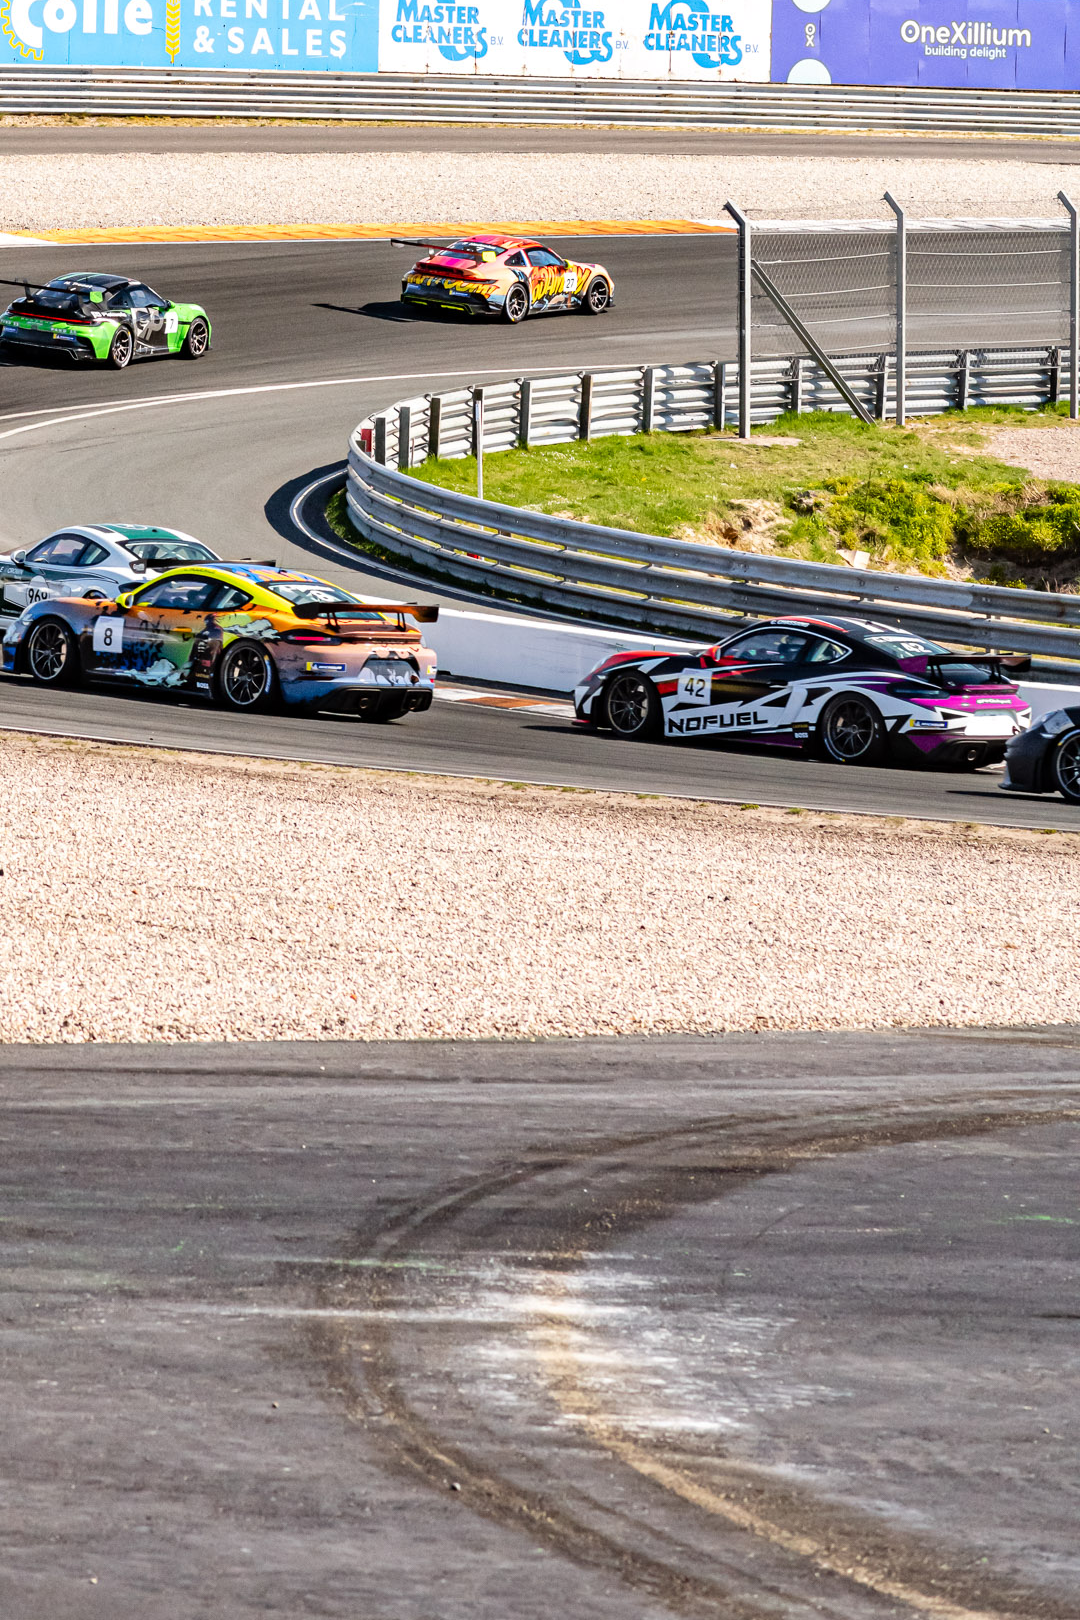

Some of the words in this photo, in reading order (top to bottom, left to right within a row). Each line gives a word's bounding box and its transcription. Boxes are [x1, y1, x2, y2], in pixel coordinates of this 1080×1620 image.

[649, 0, 734, 33] MASTER
[193, 25, 215, 54] &
[227, 26, 347, 59] SALES
[391, 25, 488, 59] CLEANERS
[490, 36, 504, 46] B.V.
[517, 28, 613, 62] CLEANERS
[615, 40, 630, 50] B.V.
[900, 19, 1032, 47] OneXillium
[643, 32, 743, 66] CLEANERS
[745, 44, 759, 54] B.V.
[924, 45, 967, 60] building
[969, 46, 1007, 60] delight
[566, 278, 574, 289] 27
[104, 627, 113, 646] 8
[684, 677, 706, 698] 42
[668, 711, 768, 734] NOFUEL
